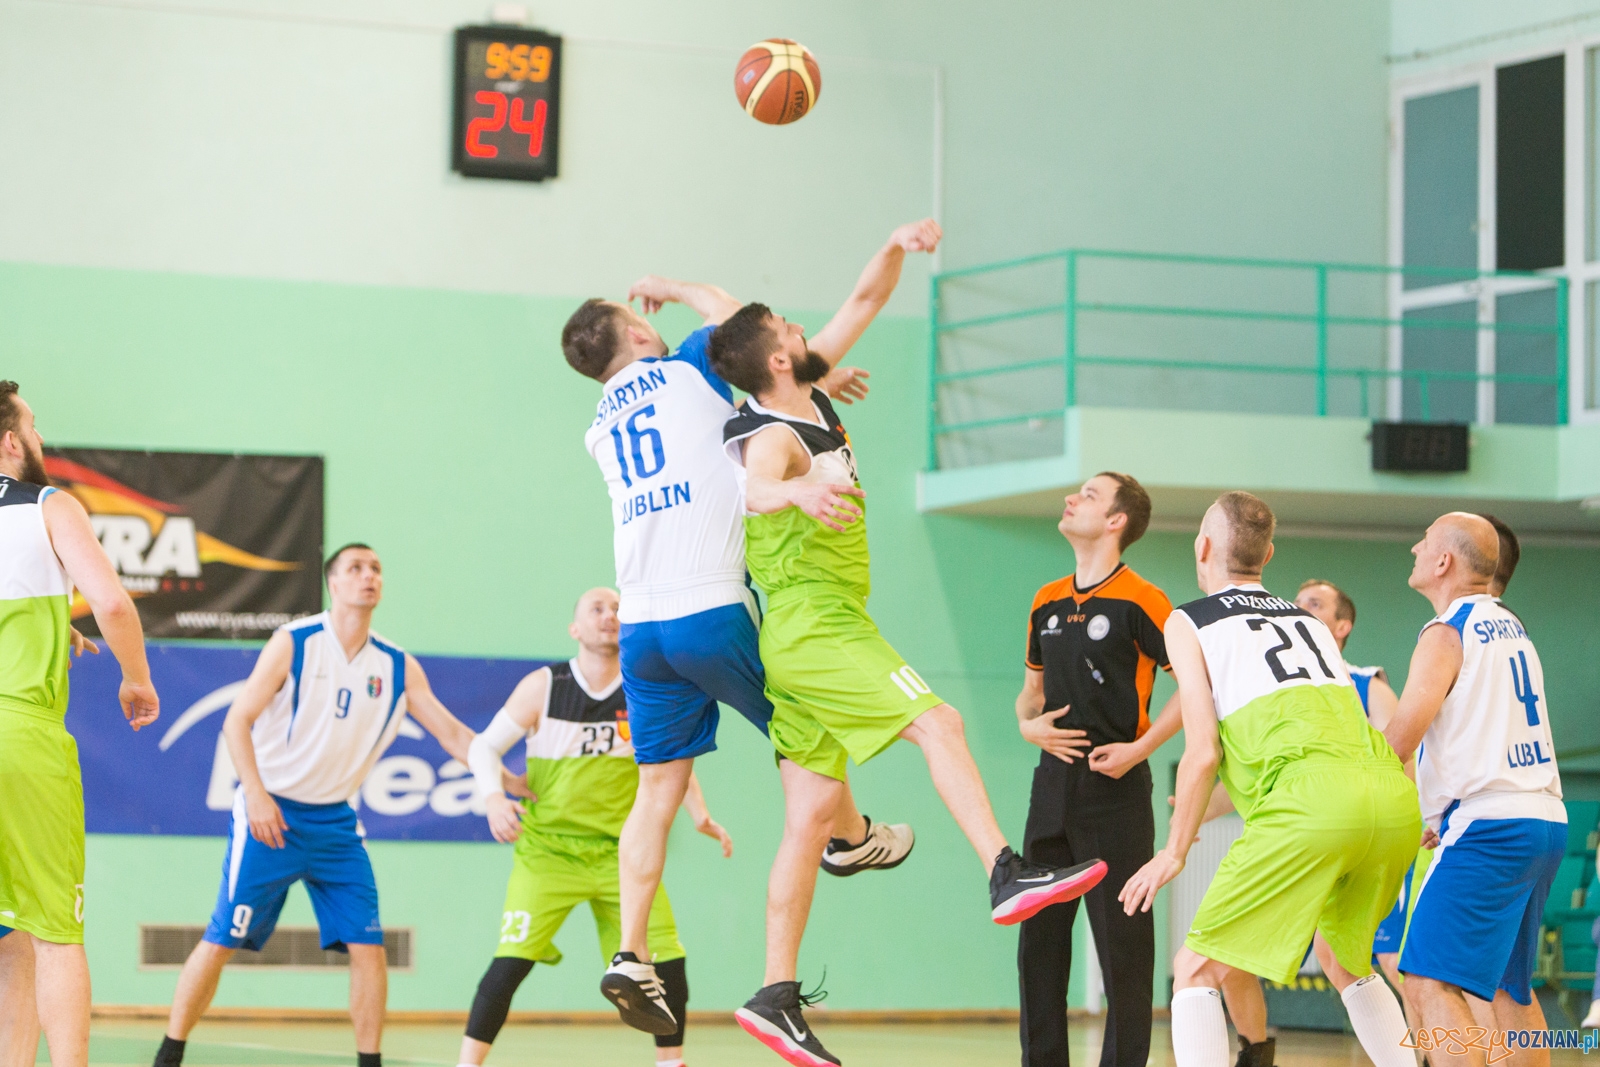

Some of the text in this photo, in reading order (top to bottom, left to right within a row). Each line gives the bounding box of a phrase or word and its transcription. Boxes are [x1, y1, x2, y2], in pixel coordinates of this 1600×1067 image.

[465, 90, 548, 159] 24
[596, 368, 667, 426] SPARTAN
[610, 403, 666, 489] 16
[1245, 618, 1336, 683] 21
[335, 687, 352, 720] 9
[890, 665, 932, 701] 10
[1509, 650, 1539, 727] 4
[582, 726, 615, 756] 23
[230, 904, 253, 938] 9
[500, 910, 532, 944] 23
